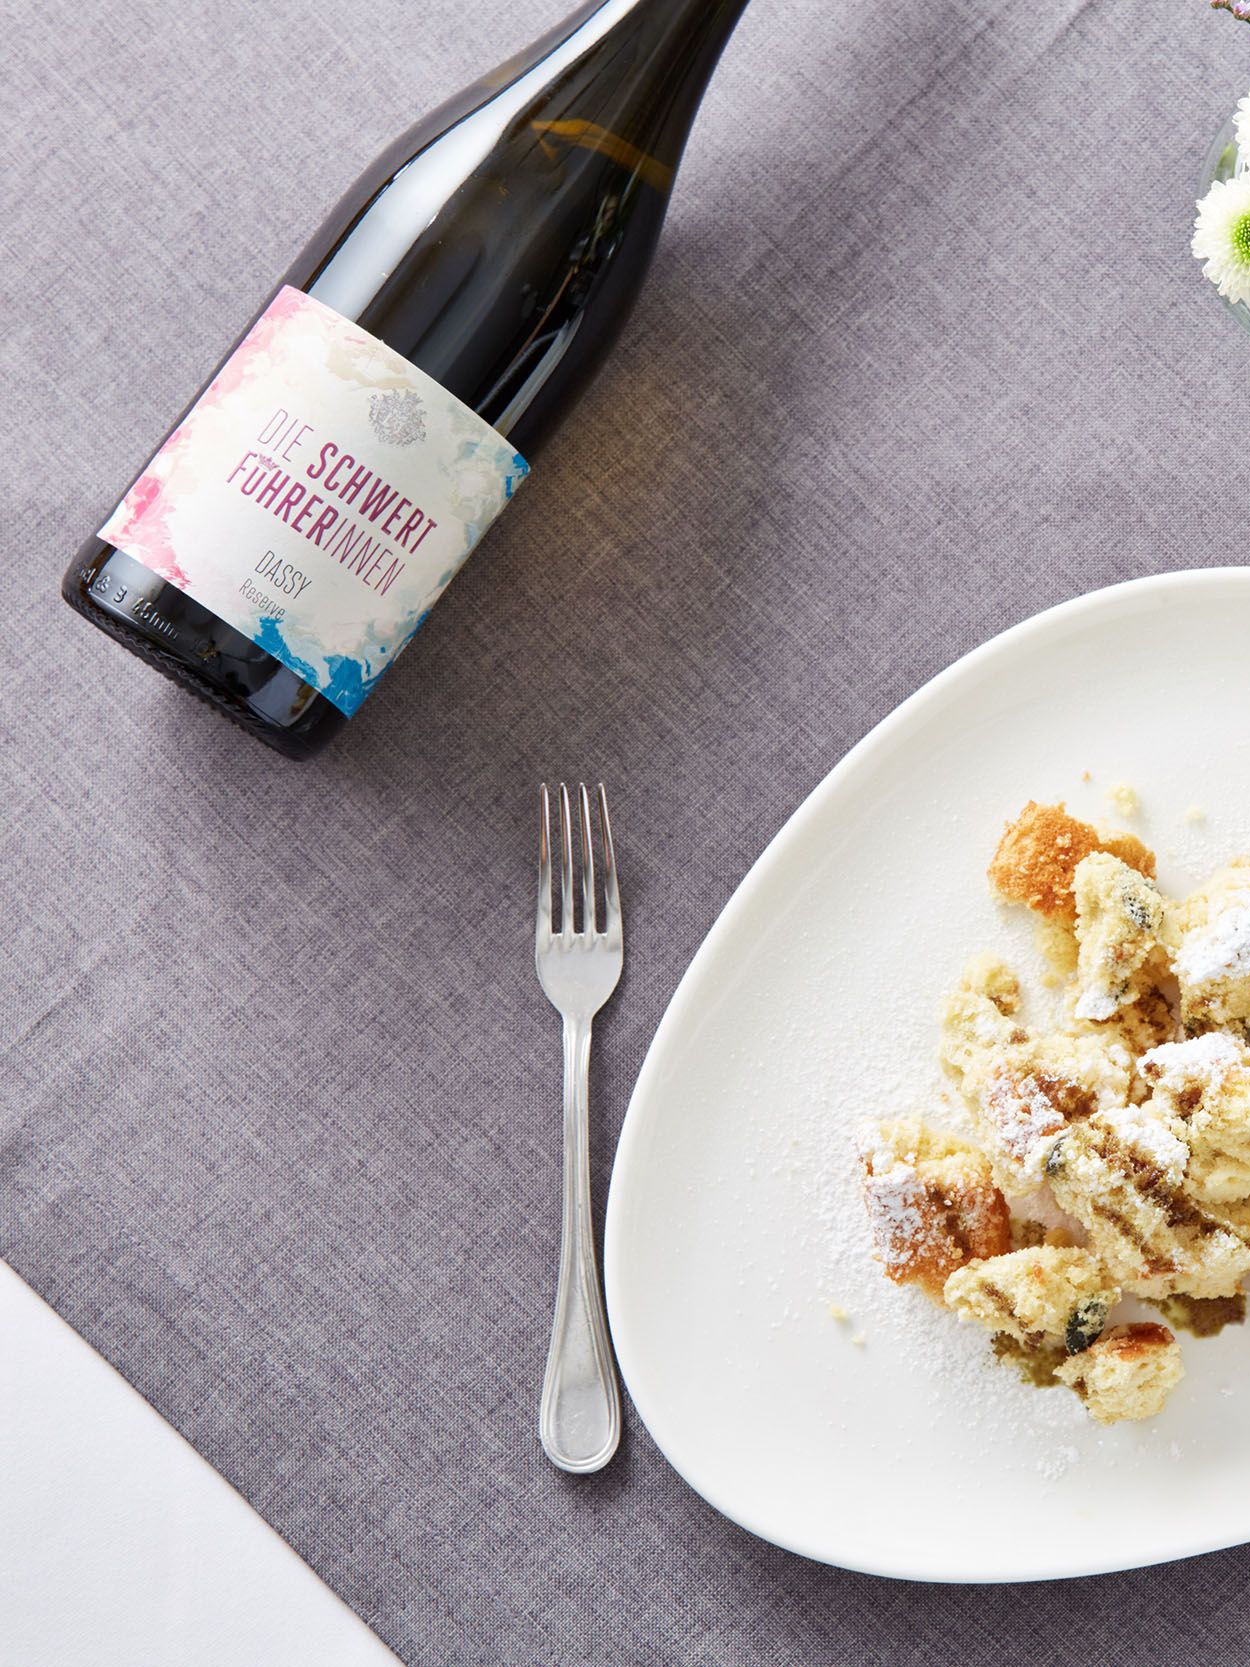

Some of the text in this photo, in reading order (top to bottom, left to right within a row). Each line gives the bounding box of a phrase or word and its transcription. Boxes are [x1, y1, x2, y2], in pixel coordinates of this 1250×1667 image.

[257, 408, 438, 554] DIE SCHWERT
[239, 578, 286, 620] Reserve
[254, 550, 312, 599] DASSY
